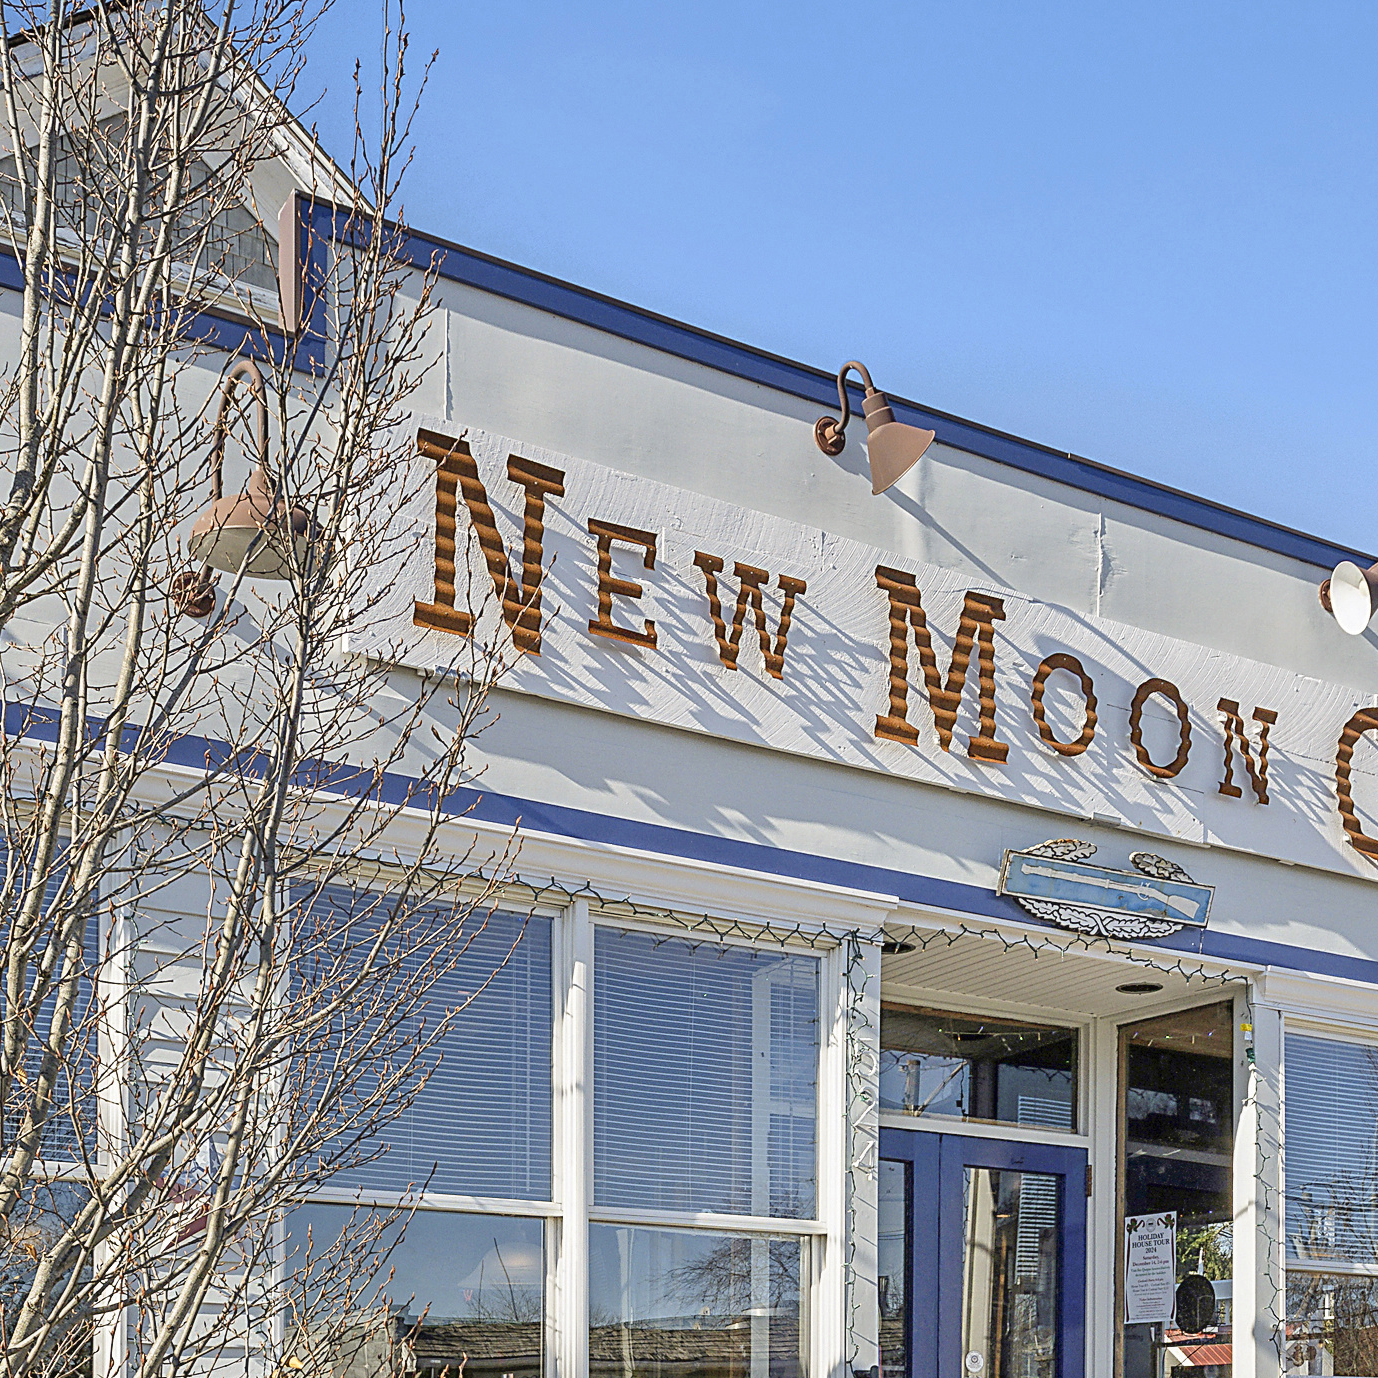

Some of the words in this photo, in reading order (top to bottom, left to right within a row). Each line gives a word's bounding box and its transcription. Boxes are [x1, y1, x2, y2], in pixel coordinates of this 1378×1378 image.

[412, 428, 807, 679] NEW
[874, 564, 1278, 805] MOON
[1138, 1232, 1165, 1241] HOLIDAY
[1132, 1240, 1153, 1248] HOUSE
[1153, 1238, 1170, 1246] TOUR
